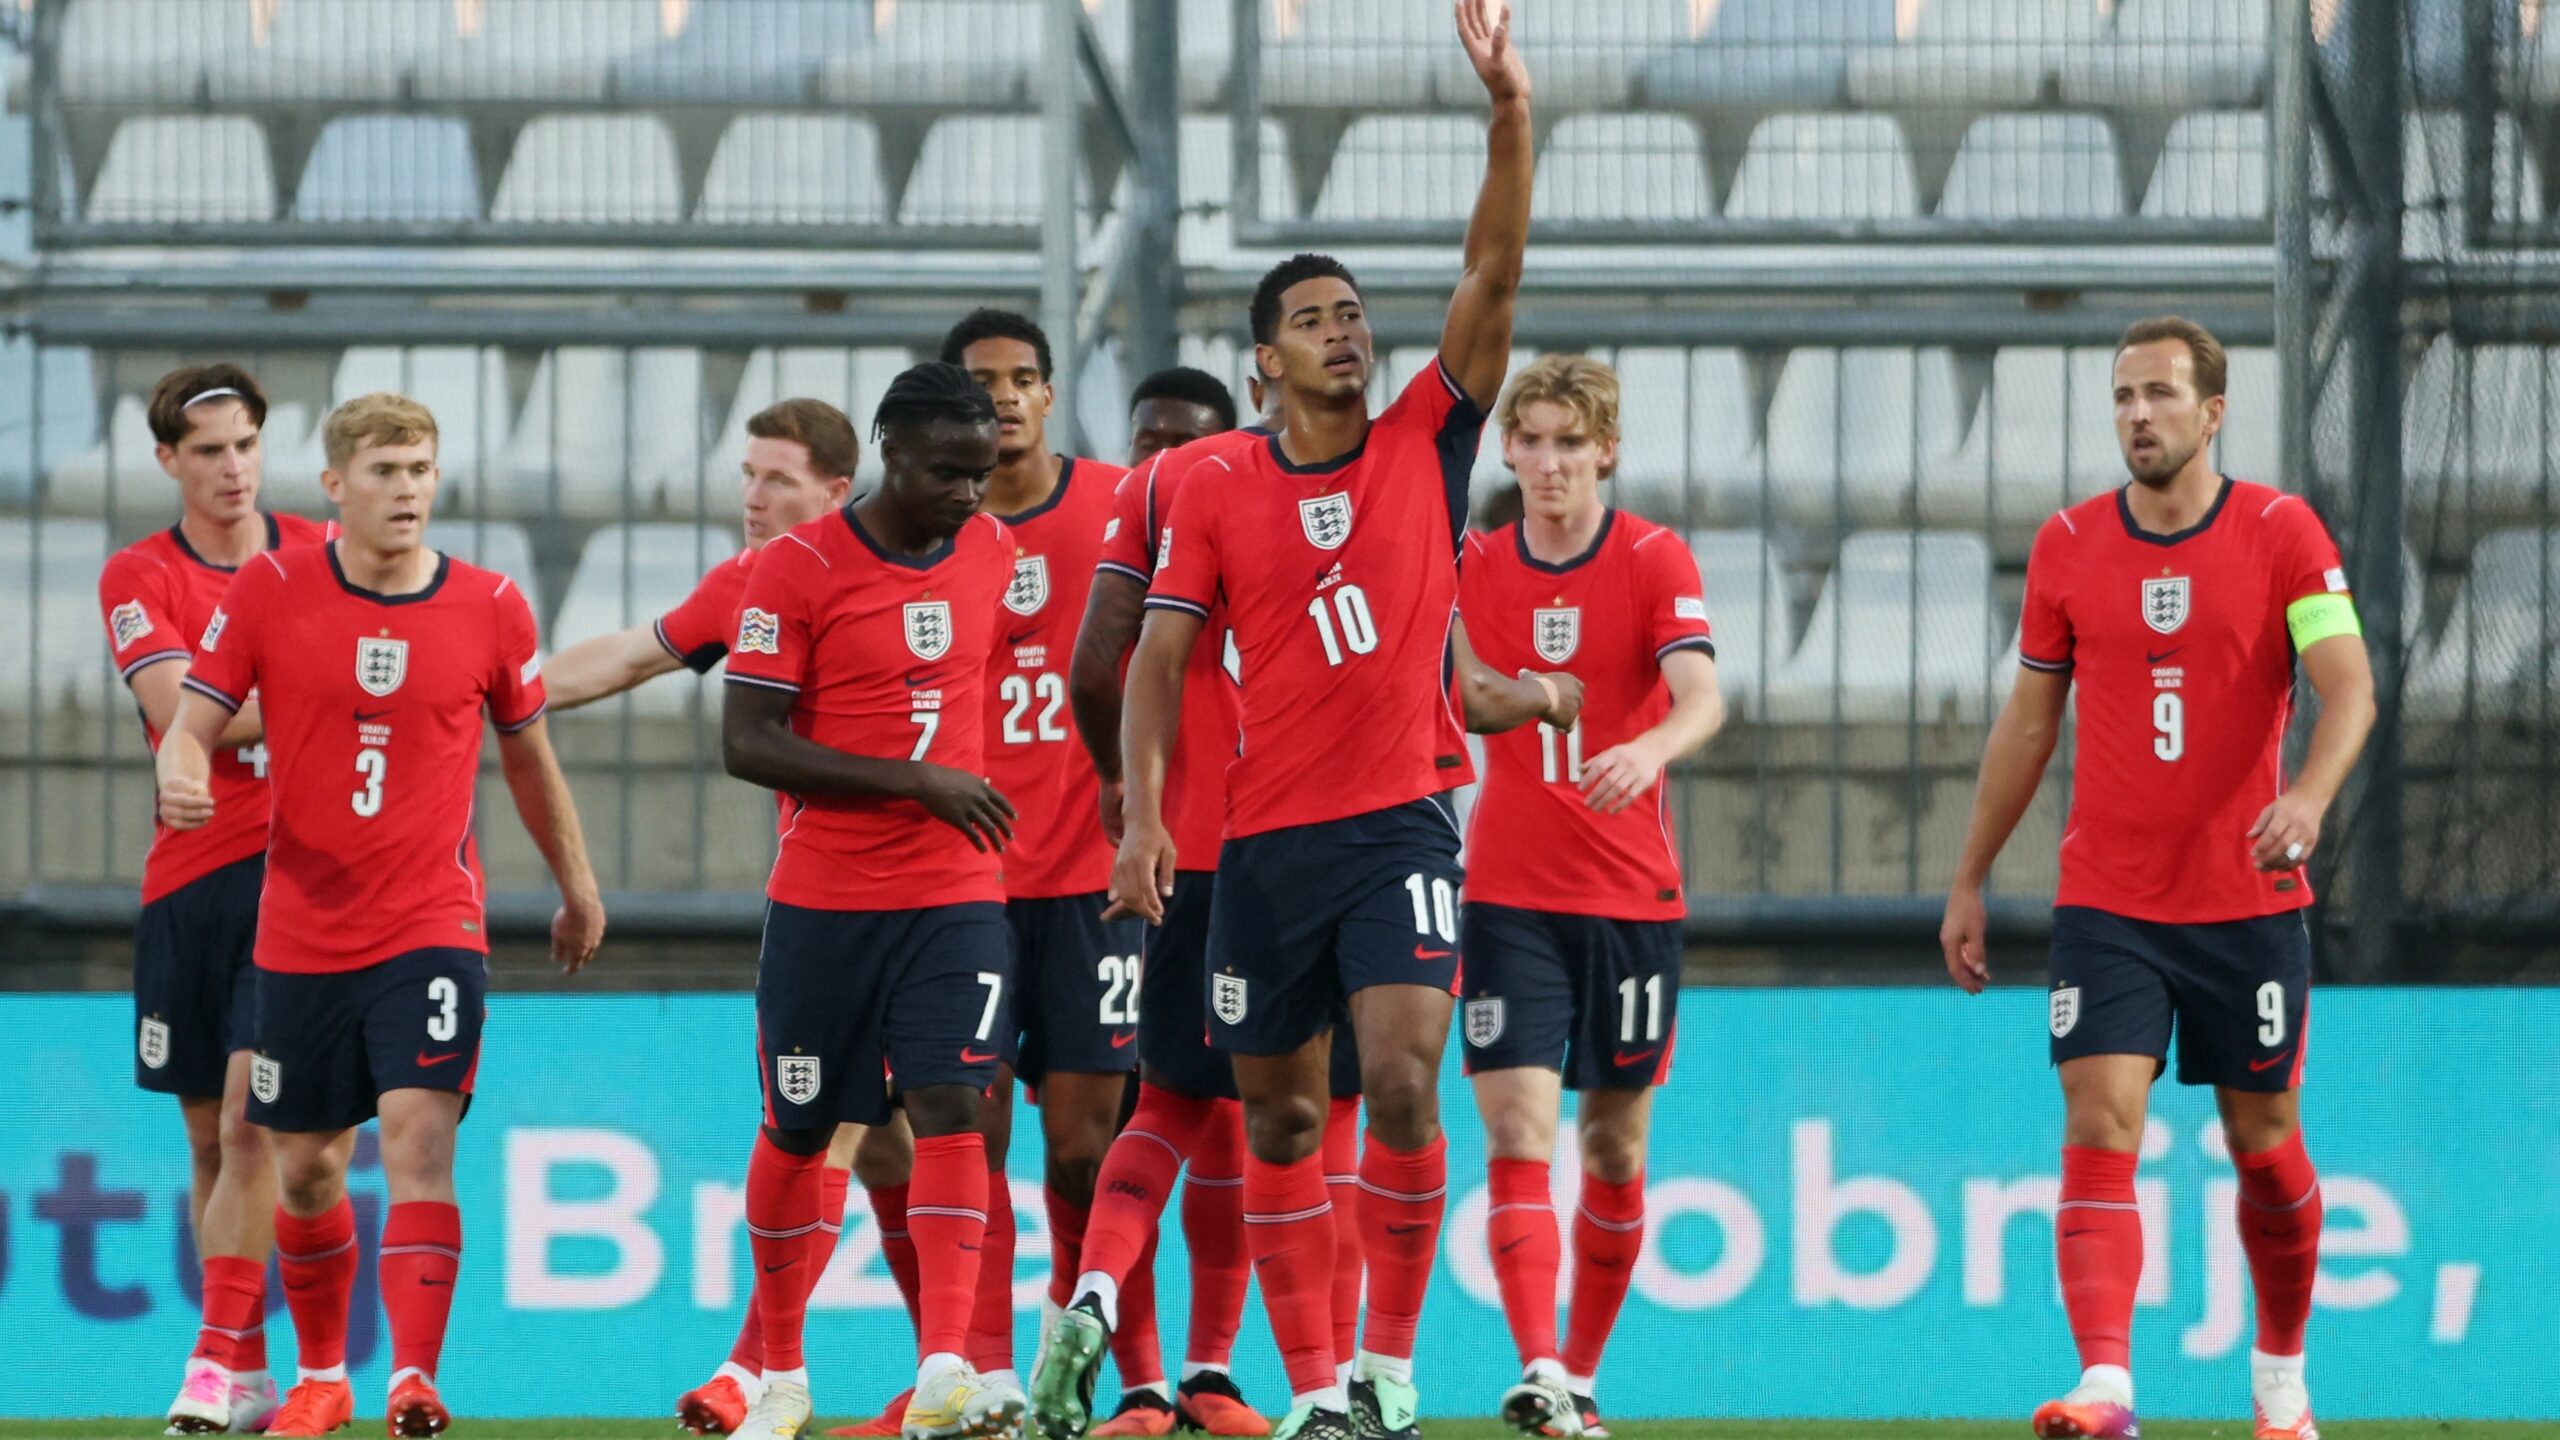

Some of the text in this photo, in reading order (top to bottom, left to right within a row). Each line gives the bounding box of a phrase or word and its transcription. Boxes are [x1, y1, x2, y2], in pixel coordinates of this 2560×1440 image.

[1308, 584, 1379, 666] 10
[909, 711, 939, 761] 7
[1000, 672, 1067, 743] 22
[2152, 692, 2185, 761] 9
[1537, 712, 1582, 782] 11
[351, 748, 388, 817] 3
[1405, 872, 1456, 944] 10
[427, 976, 458, 1041] 3
[975, 971, 1002, 1042] 7
[1098, 953, 1140, 1025] 22
[1618, 973, 1662, 1042] 11
[2256, 980, 2286, 1047] 9
